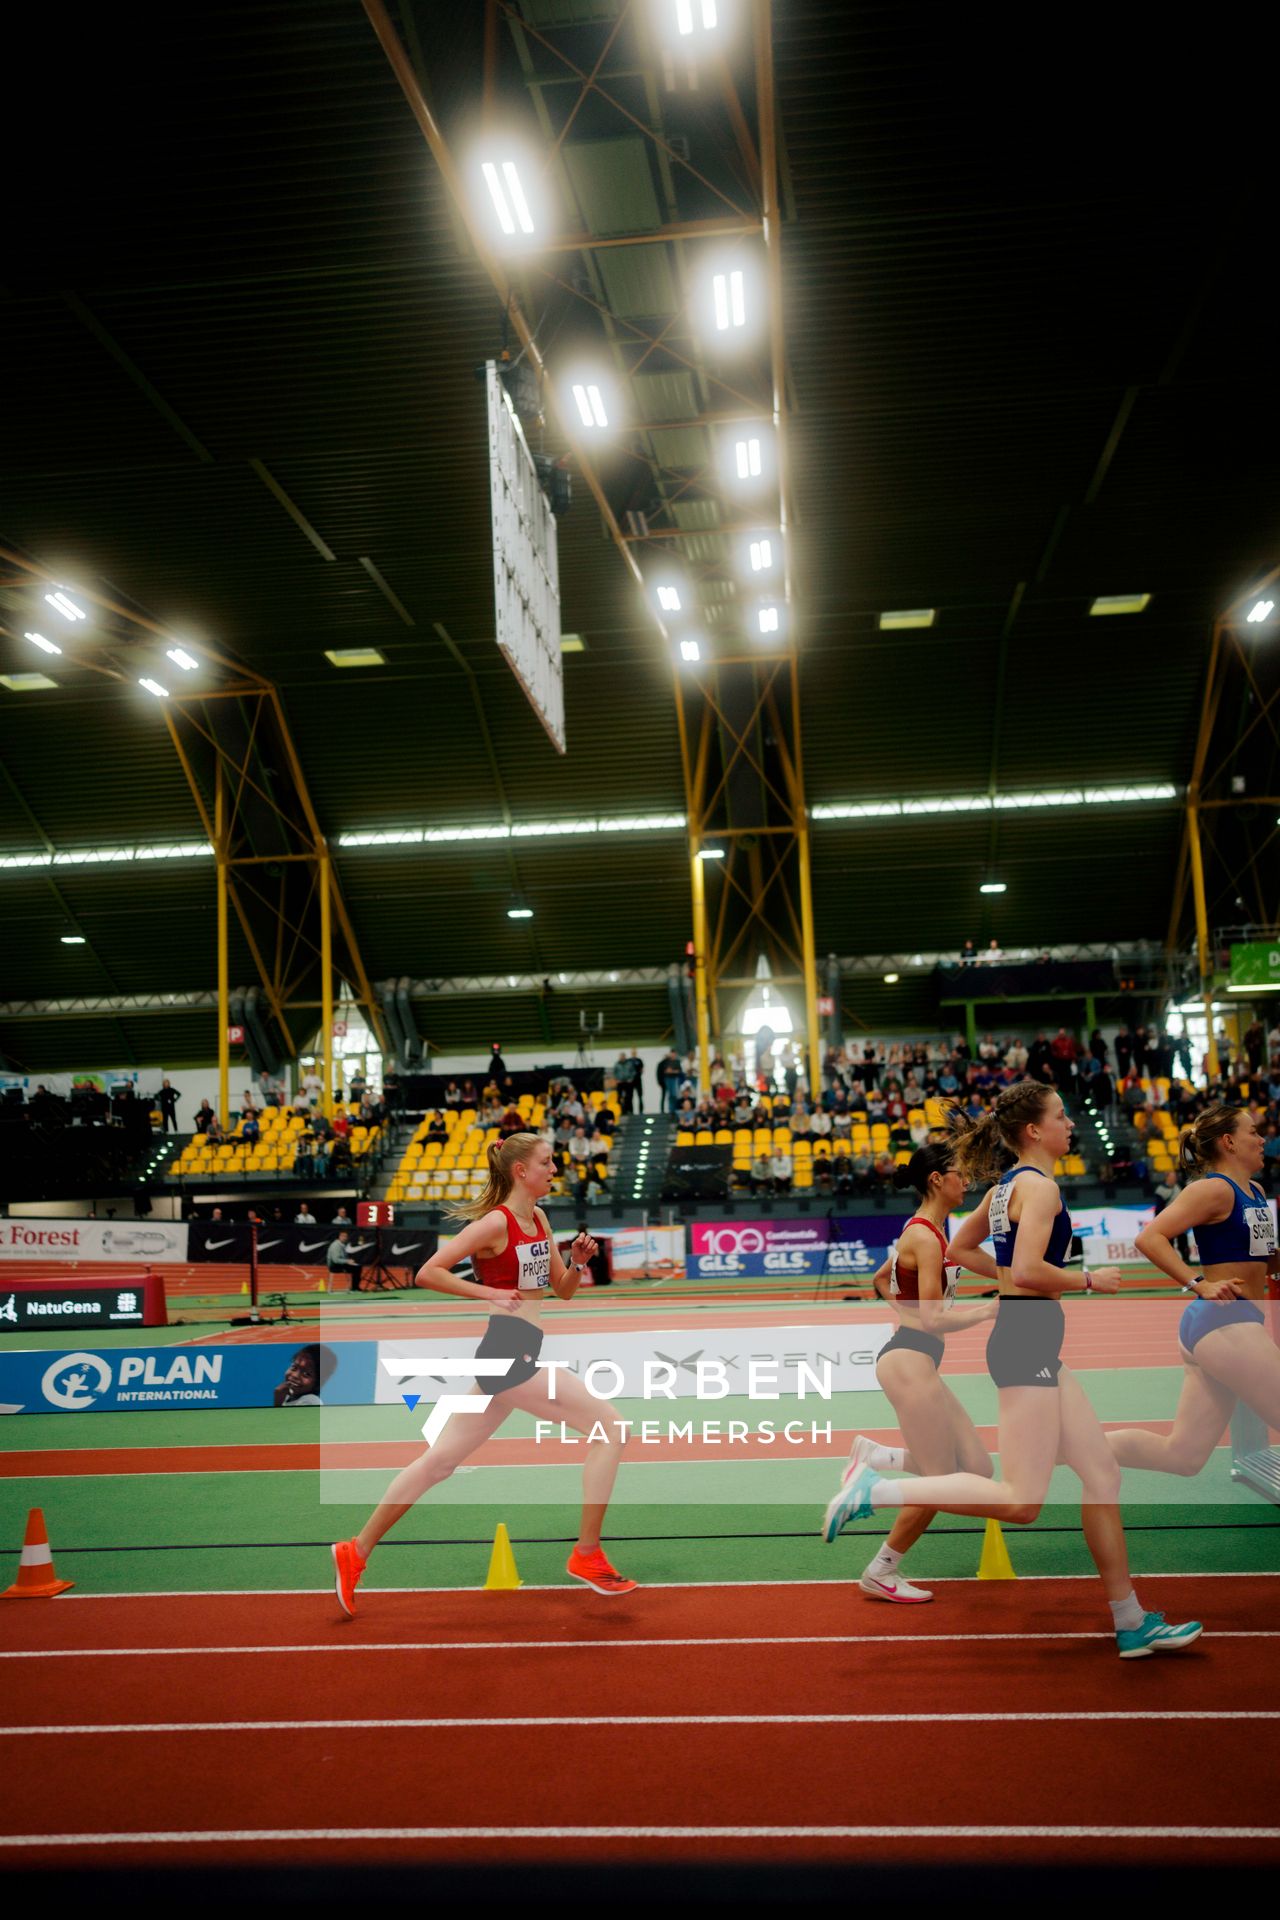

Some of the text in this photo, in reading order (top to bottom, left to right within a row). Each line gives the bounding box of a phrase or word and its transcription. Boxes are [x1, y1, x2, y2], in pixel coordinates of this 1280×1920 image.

[367, 1205, 378, 1222] 3
[11, 1226, 80, 1246] Forest
[701, 1227, 765, 1255] 100
[530, 1241, 549, 1257] GLS
[1107, 1243, 1144, 1260] Bla
[27, 1301, 101, 1315] NatuGena
[119, 1354, 223, 1386] PLAN
[117, 1389, 218, 1402] INTERNATIONAL
